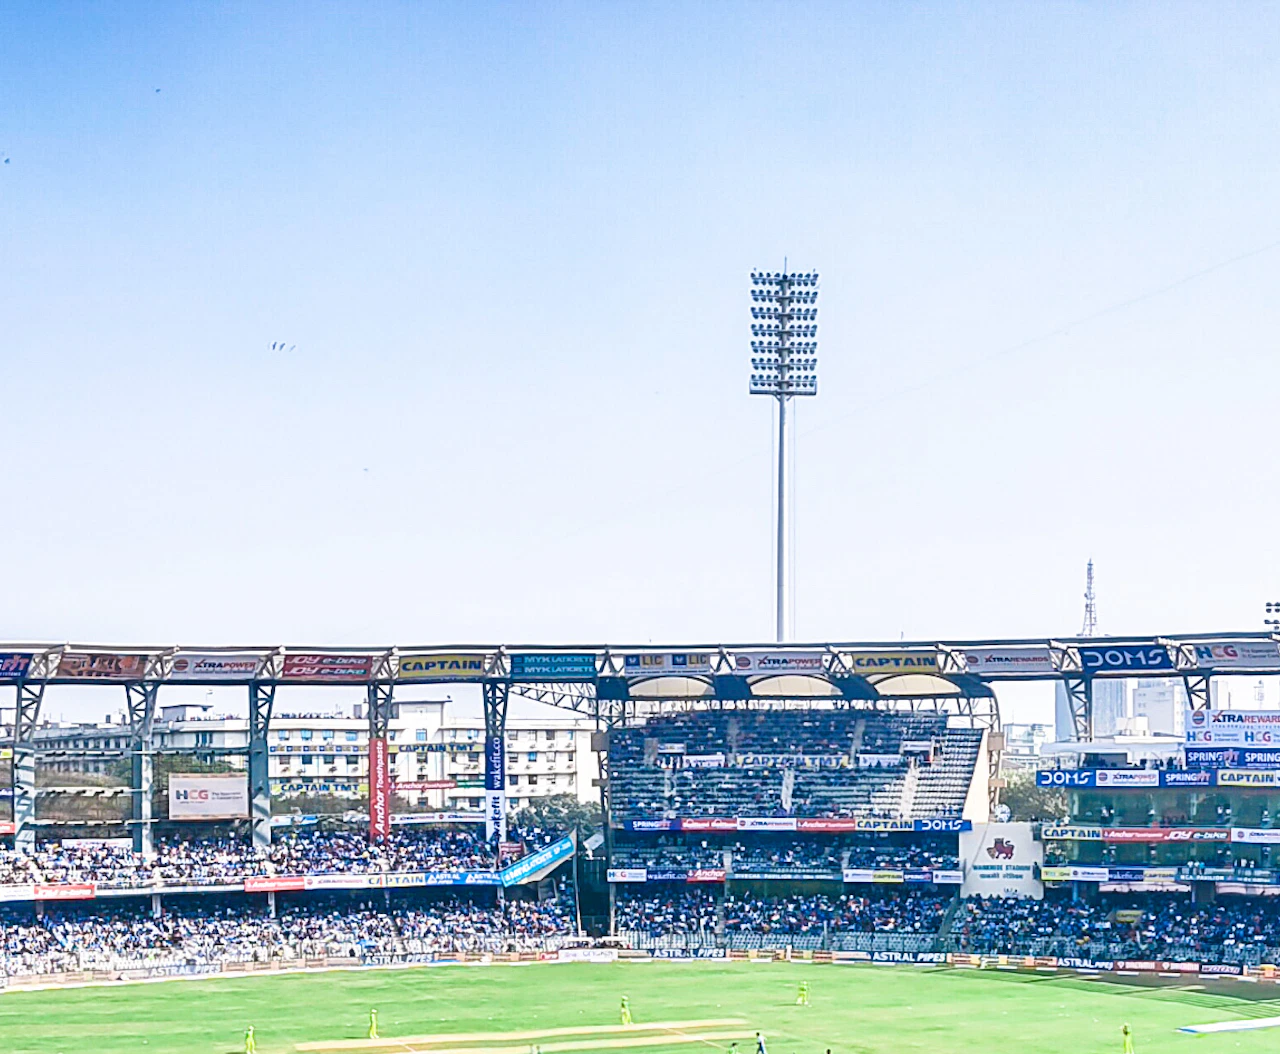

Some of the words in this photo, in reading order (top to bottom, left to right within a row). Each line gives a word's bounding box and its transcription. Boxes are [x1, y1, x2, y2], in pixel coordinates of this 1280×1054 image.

[1197, 644, 1239, 659] HCG
[286, 655, 318, 665] JOY
[524, 655, 551, 664] MYK
[642, 654, 663, 667] LIC
[689, 653, 707, 666] LIC
[758, 656, 821, 667] XTRAPOWER
[855, 656, 936, 668] CAPTAIN
[984, 654, 1049, 664] XTRAREWARDS
[1086, 649, 1166, 668] DOMS
[194, 658, 256, 671] XTRAPOWER
[401, 660, 482, 672] CAPTAIN
[524, 665, 551, 674] MYK
[284, 666, 318, 676] JOY
[1186, 731, 1212, 742] HCG
[1244, 730, 1271, 743] HCG
[398, 744, 446, 752] CAPTAIN
[448, 744, 475, 752] TMT
[376, 740, 385, 789] Toothpaste
[489, 737, 501, 789] wakefit.co
[1040, 771, 1094, 785] DOMS
[1165, 770, 1212, 782] SPRINGFIT
[1220, 773, 1274, 783] CAPTAIN
[280, 783, 332, 792] CAPTAIN
[333, 783, 360, 792] TMT
[175, 789, 210, 801] HCG
[374, 791, 387, 834] Anchor
[856, 820, 913, 830] CAPTAIN
[921, 819, 963, 831] DOMS
[1043, 828, 1101, 838] CAPTAIN
[1163, 830, 1192, 840] JOY
[1193, 831, 1228, 840] e-bike
[694, 869, 726, 878] Anchor
[653, 948, 695, 958] ASTRAL
[696, 948, 725, 958] PIPES
[872, 952, 915, 962] ASTRAL
[916, 952, 946, 963] PIPES
[365, 954, 404, 965] ASTRAL
[405, 953, 433, 964] PIPES
